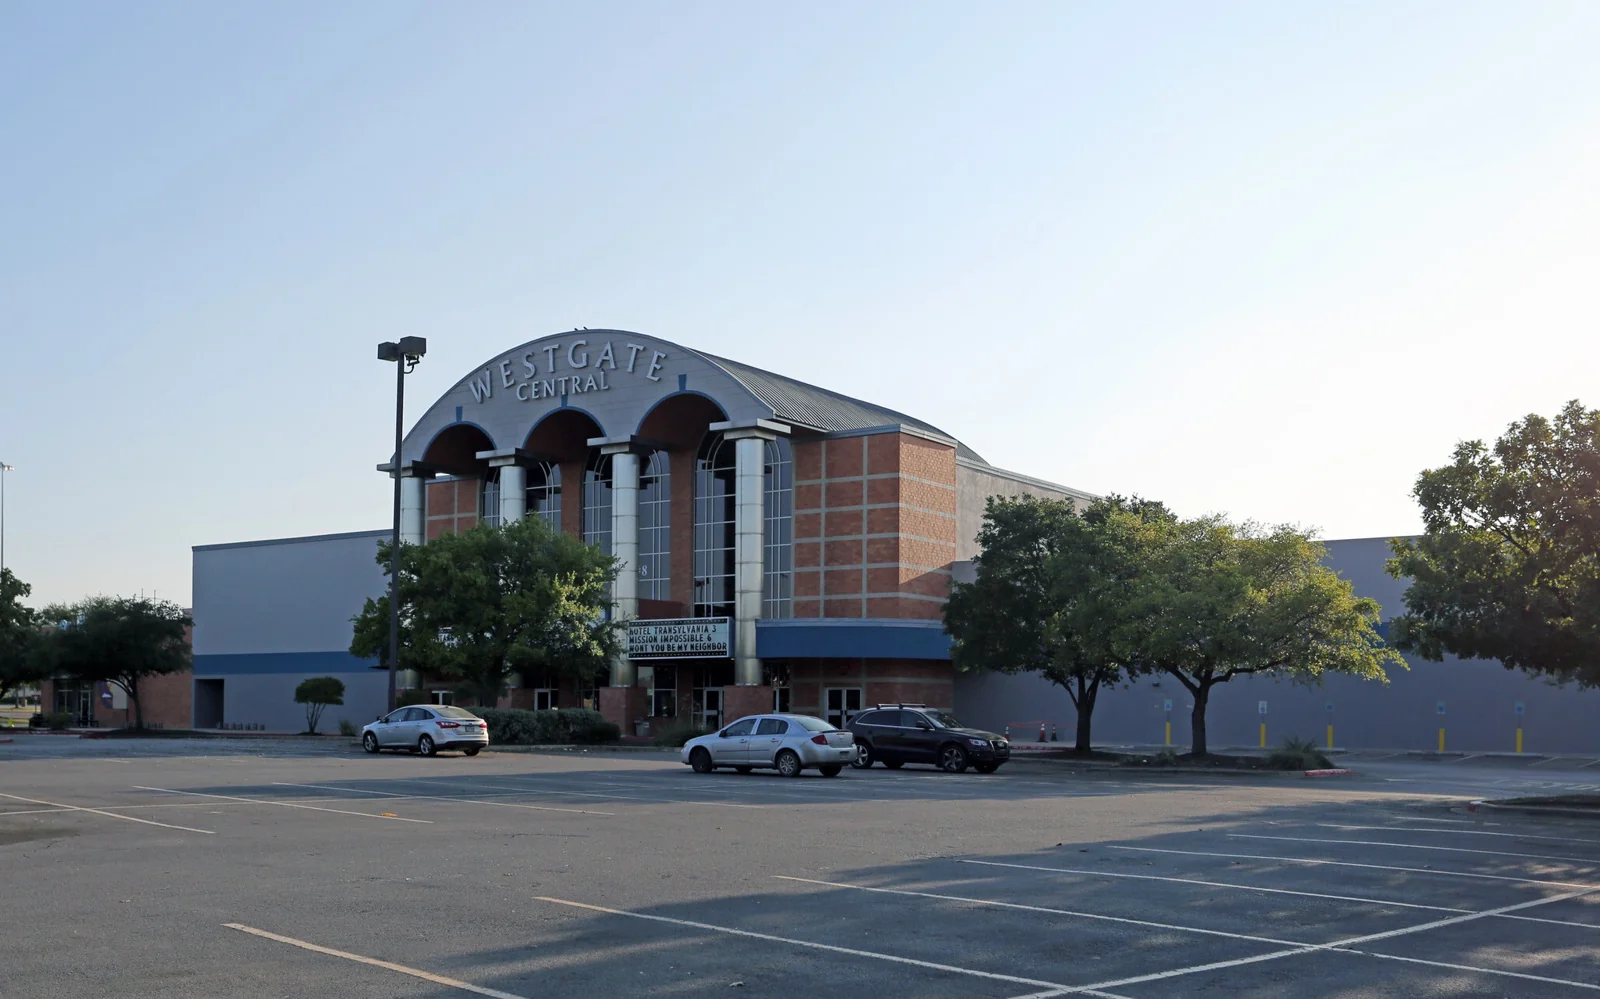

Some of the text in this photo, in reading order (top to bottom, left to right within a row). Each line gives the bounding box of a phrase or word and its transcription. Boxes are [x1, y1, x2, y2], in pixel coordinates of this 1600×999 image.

[468, 340, 666, 403] WESTGATE
[516, 371, 609, 401] CENTRAL
[630, 627, 650, 636] HOTEL
[654, 625, 708, 634] TRANSYLVANIA
[630, 636, 658, 644] MISSION
[660, 634, 703, 642] IMPOSSIBLE
[690, 642, 727, 650] NEIGHBOR
